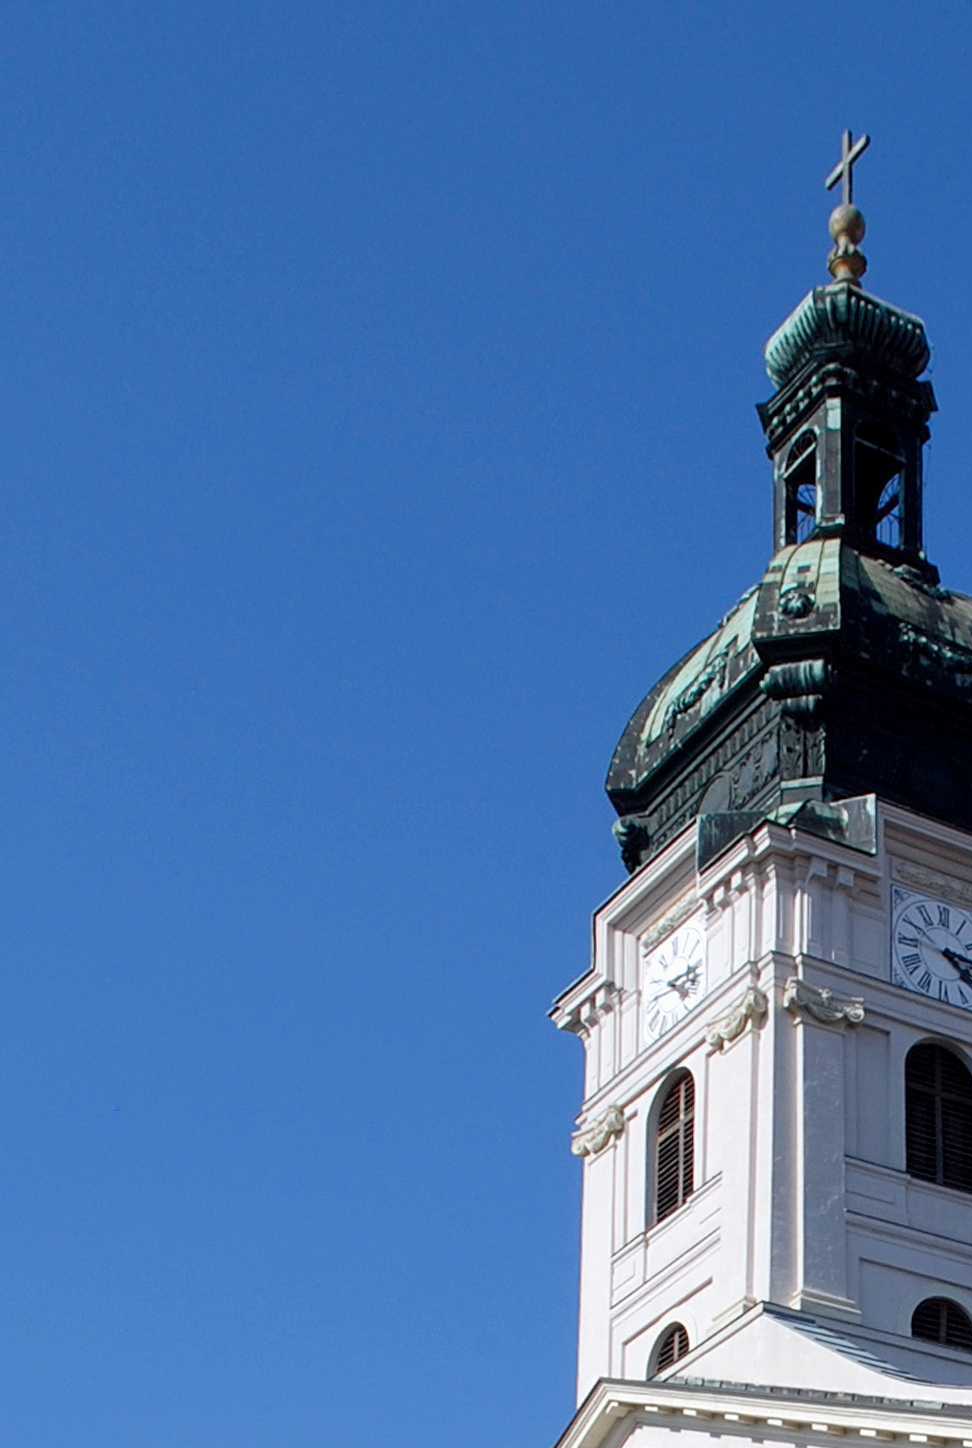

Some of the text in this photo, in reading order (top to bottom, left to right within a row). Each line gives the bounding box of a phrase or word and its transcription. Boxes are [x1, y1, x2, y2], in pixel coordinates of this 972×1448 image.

[915, 904, 934, 927] XI
[936, 904, 950, 929] XII
[955, 919, 967, 936] I
